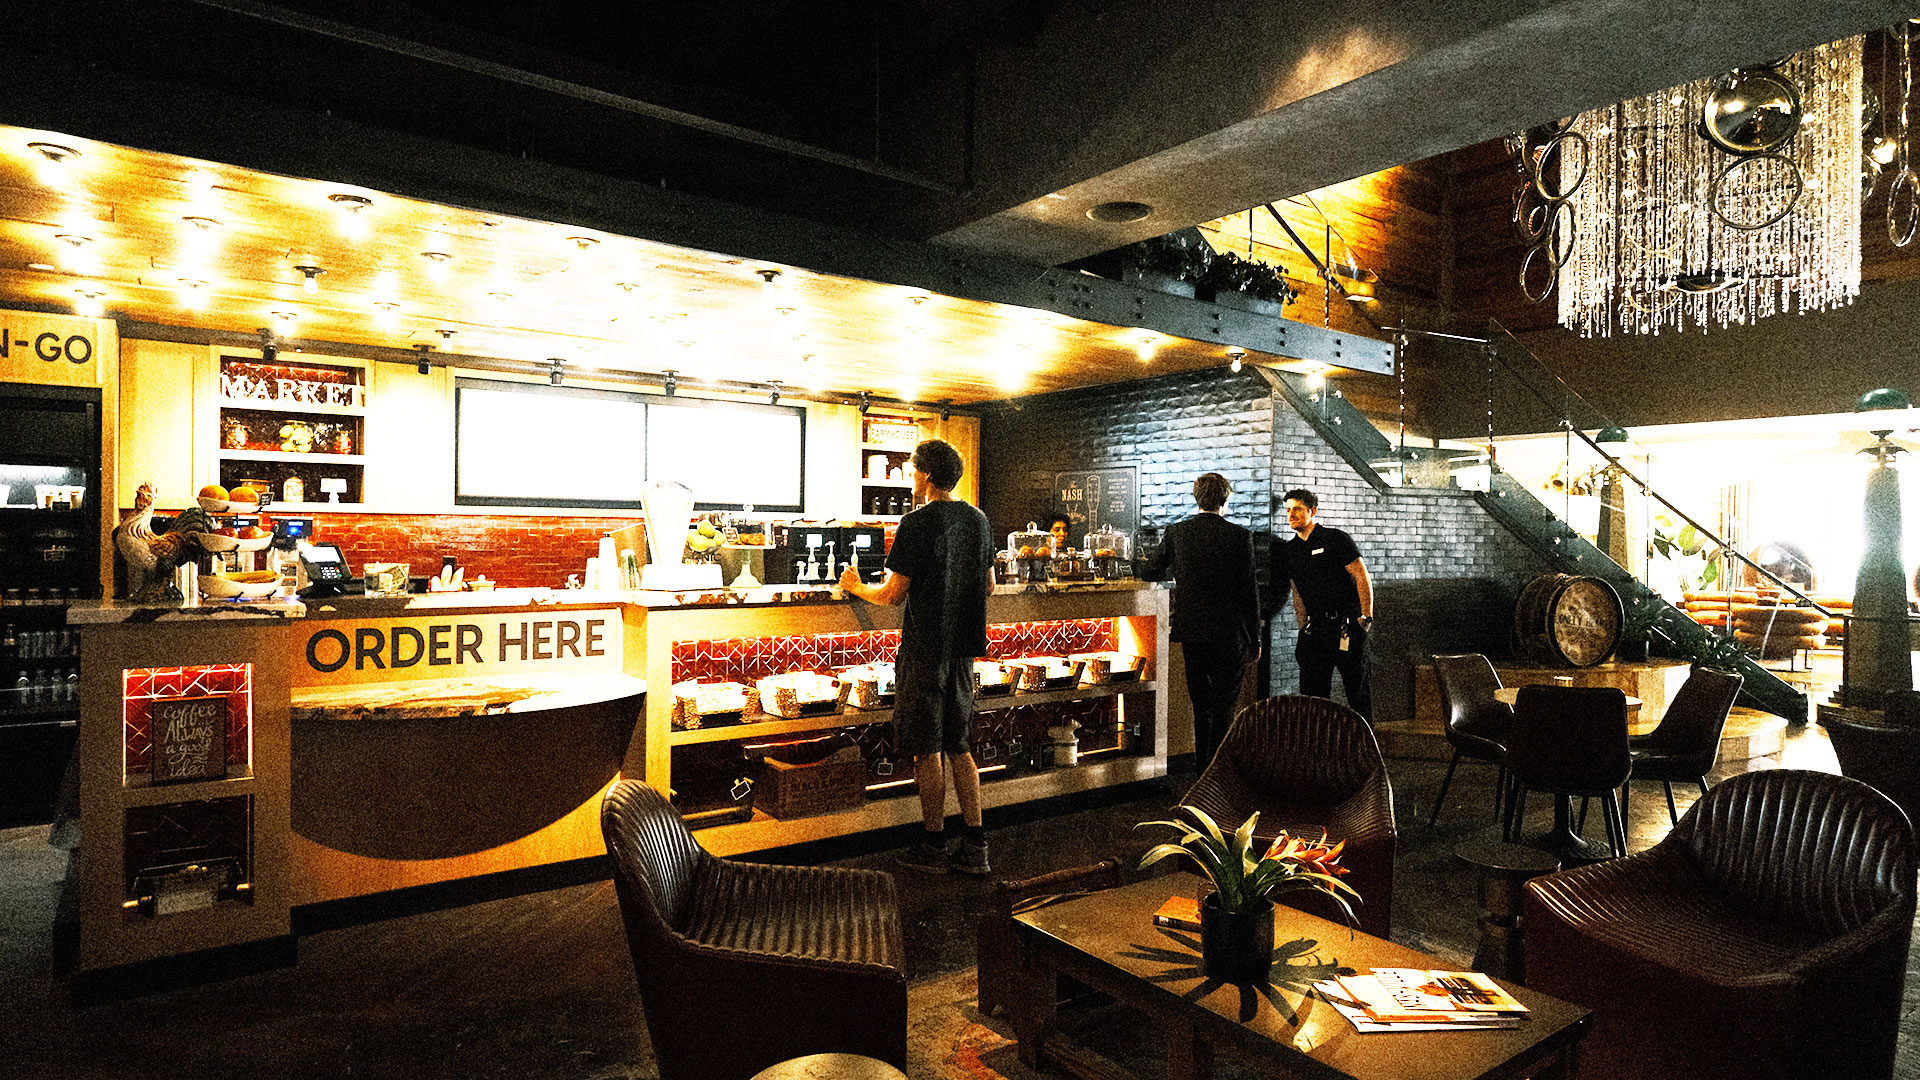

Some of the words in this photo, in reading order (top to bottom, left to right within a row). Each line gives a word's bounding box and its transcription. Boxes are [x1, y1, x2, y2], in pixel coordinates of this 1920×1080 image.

[221, 371, 364, 407] MARKET
[1061, 488, 1083, 502] NASH
[306, 623, 484, 673] ORDER
[499, 619, 605, 661] HERE
[165, 744, 176, 755] a
[169, 737, 212, 764] good
[170, 759, 208, 777] idea
